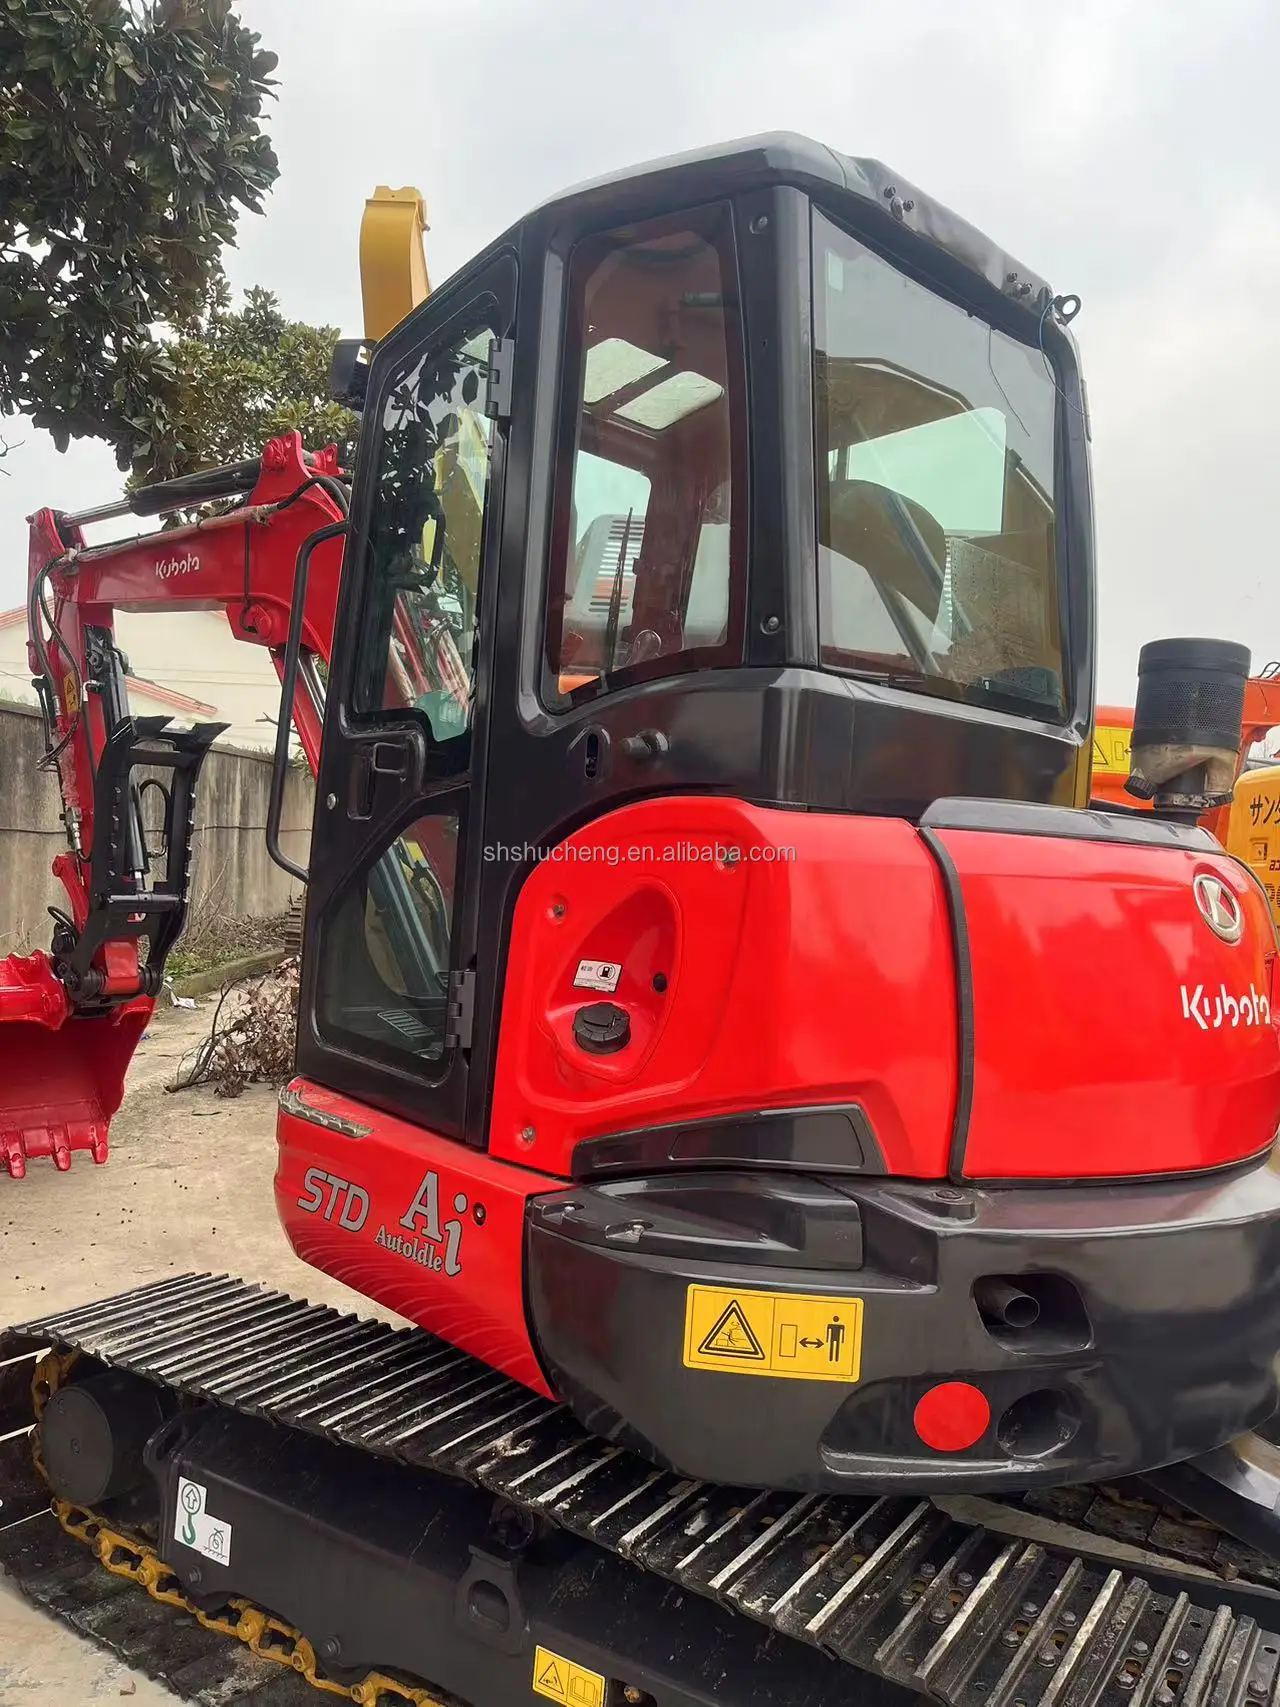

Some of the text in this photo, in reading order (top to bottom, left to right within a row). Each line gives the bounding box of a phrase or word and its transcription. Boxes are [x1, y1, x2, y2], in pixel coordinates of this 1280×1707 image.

[155, 552, 200, 580] Kubota
[1180, 982, 1271, 1030] Kubota
[297, 1166, 370, 1232] STD
